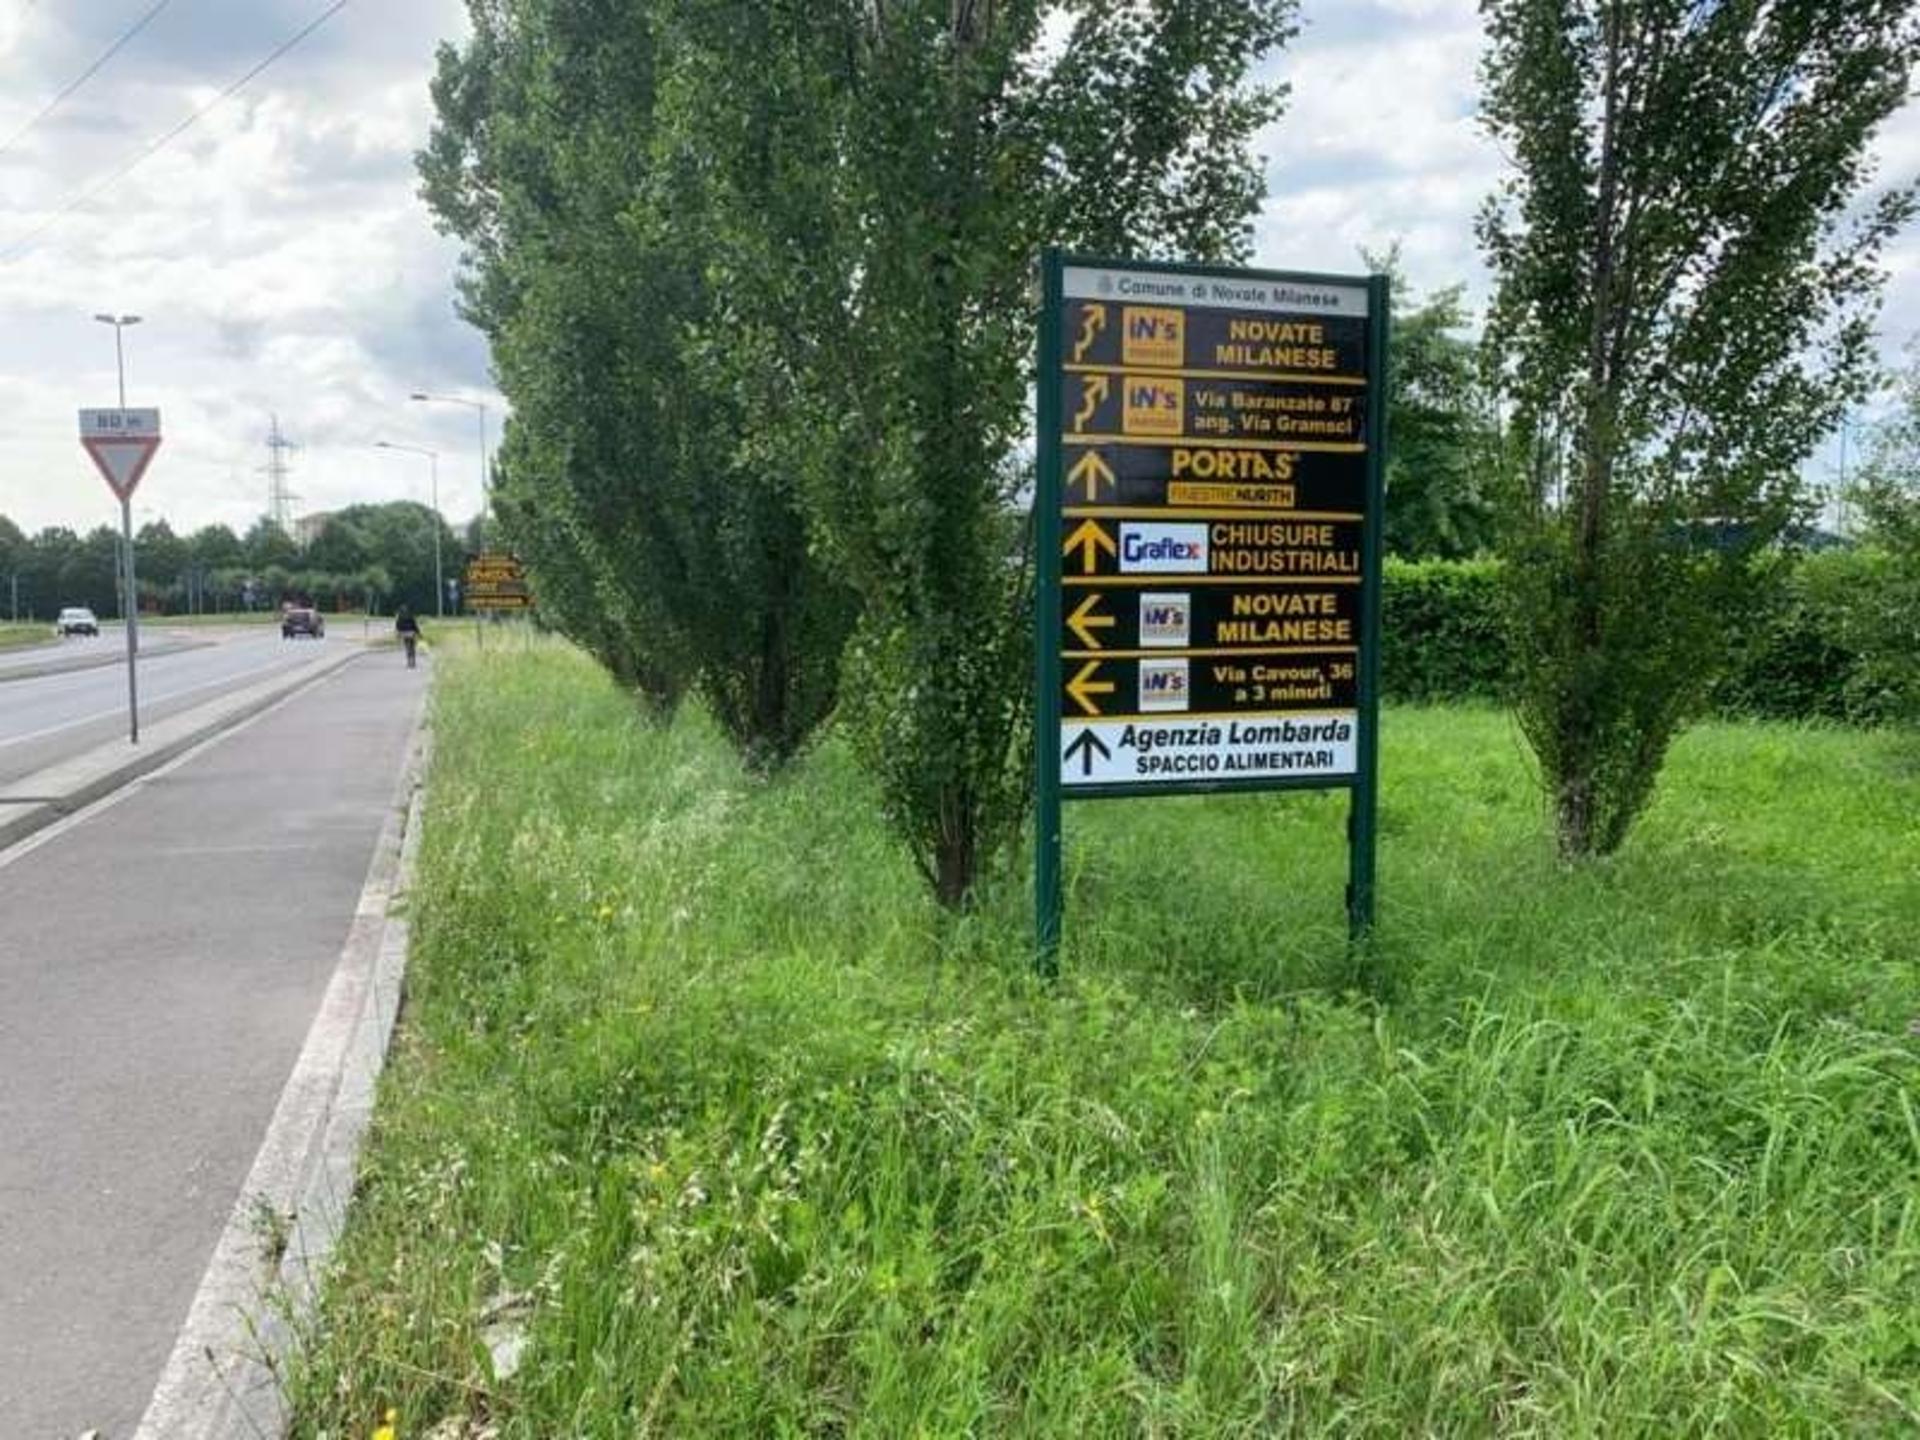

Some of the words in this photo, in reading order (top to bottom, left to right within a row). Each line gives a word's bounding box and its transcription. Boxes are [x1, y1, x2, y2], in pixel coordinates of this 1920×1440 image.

[1118, 276, 1184, 296] Comune
[1212, 284, 1266, 302] Novate
[1273, 287, 1339, 306] Milanese
[1230, 320, 1324, 345] NOVATE
[1215, 344, 1336, 369] MILANESE
[1194, 391, 1225, 409] Via
[1232, 391, 1326, 412] Baranzate
[1241, 413, 1271, 431] Via
[1276, 414, 1353, 434] Gramsci
[1172, 449, 1293, 480] PORTAS
[1211, 524, 1334, 547] CHIUSURE
[1123, 533, 1200, 563] Graflex
[1210, 549, 1360, 572] INDUSTRIALI
[1233, 594, 1337, 616] NOVATE
[1218, 619, 1351, 643] MILANESE
[1214, 665, 1247, 682] Via
[1330, 662, 1354, 681] 36
[1235, 687, 1248, 702] a
[1254, 685, 1266, 702] 3
[1271, 683, 1333, 701] minuti
[1119, 723, 1222, 752] Agenzia
[1228, 718, 1351, 746] Lombarda
[1136, 752, 1220, 775] SPACCIO
[1222, 748, 1334, 772] ALIMENTARI
